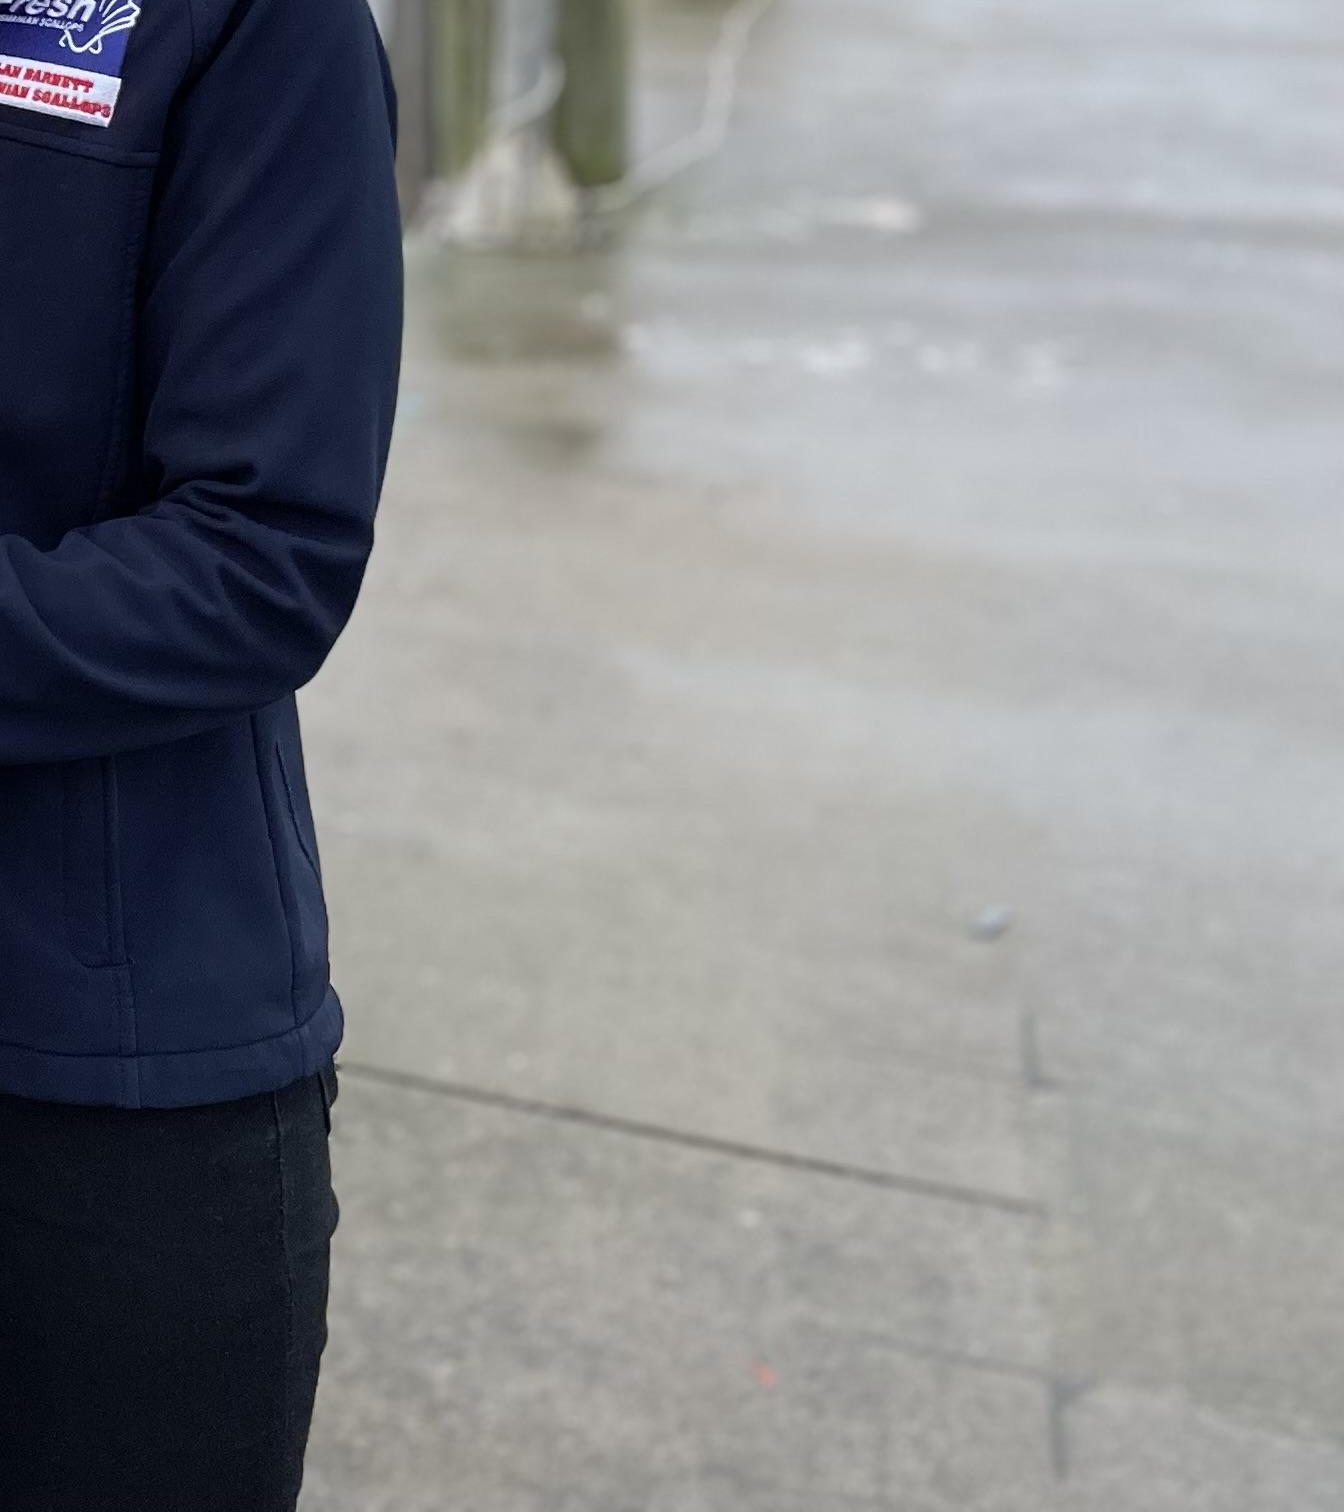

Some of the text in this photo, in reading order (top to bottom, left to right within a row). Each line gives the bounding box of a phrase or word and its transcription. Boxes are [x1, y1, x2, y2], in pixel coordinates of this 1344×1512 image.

[39, 17, 84, 32] SCALLOPS
[23, 68, 94, 94] BARNETT
[32, 88, 112, 118] SCALLOPS
